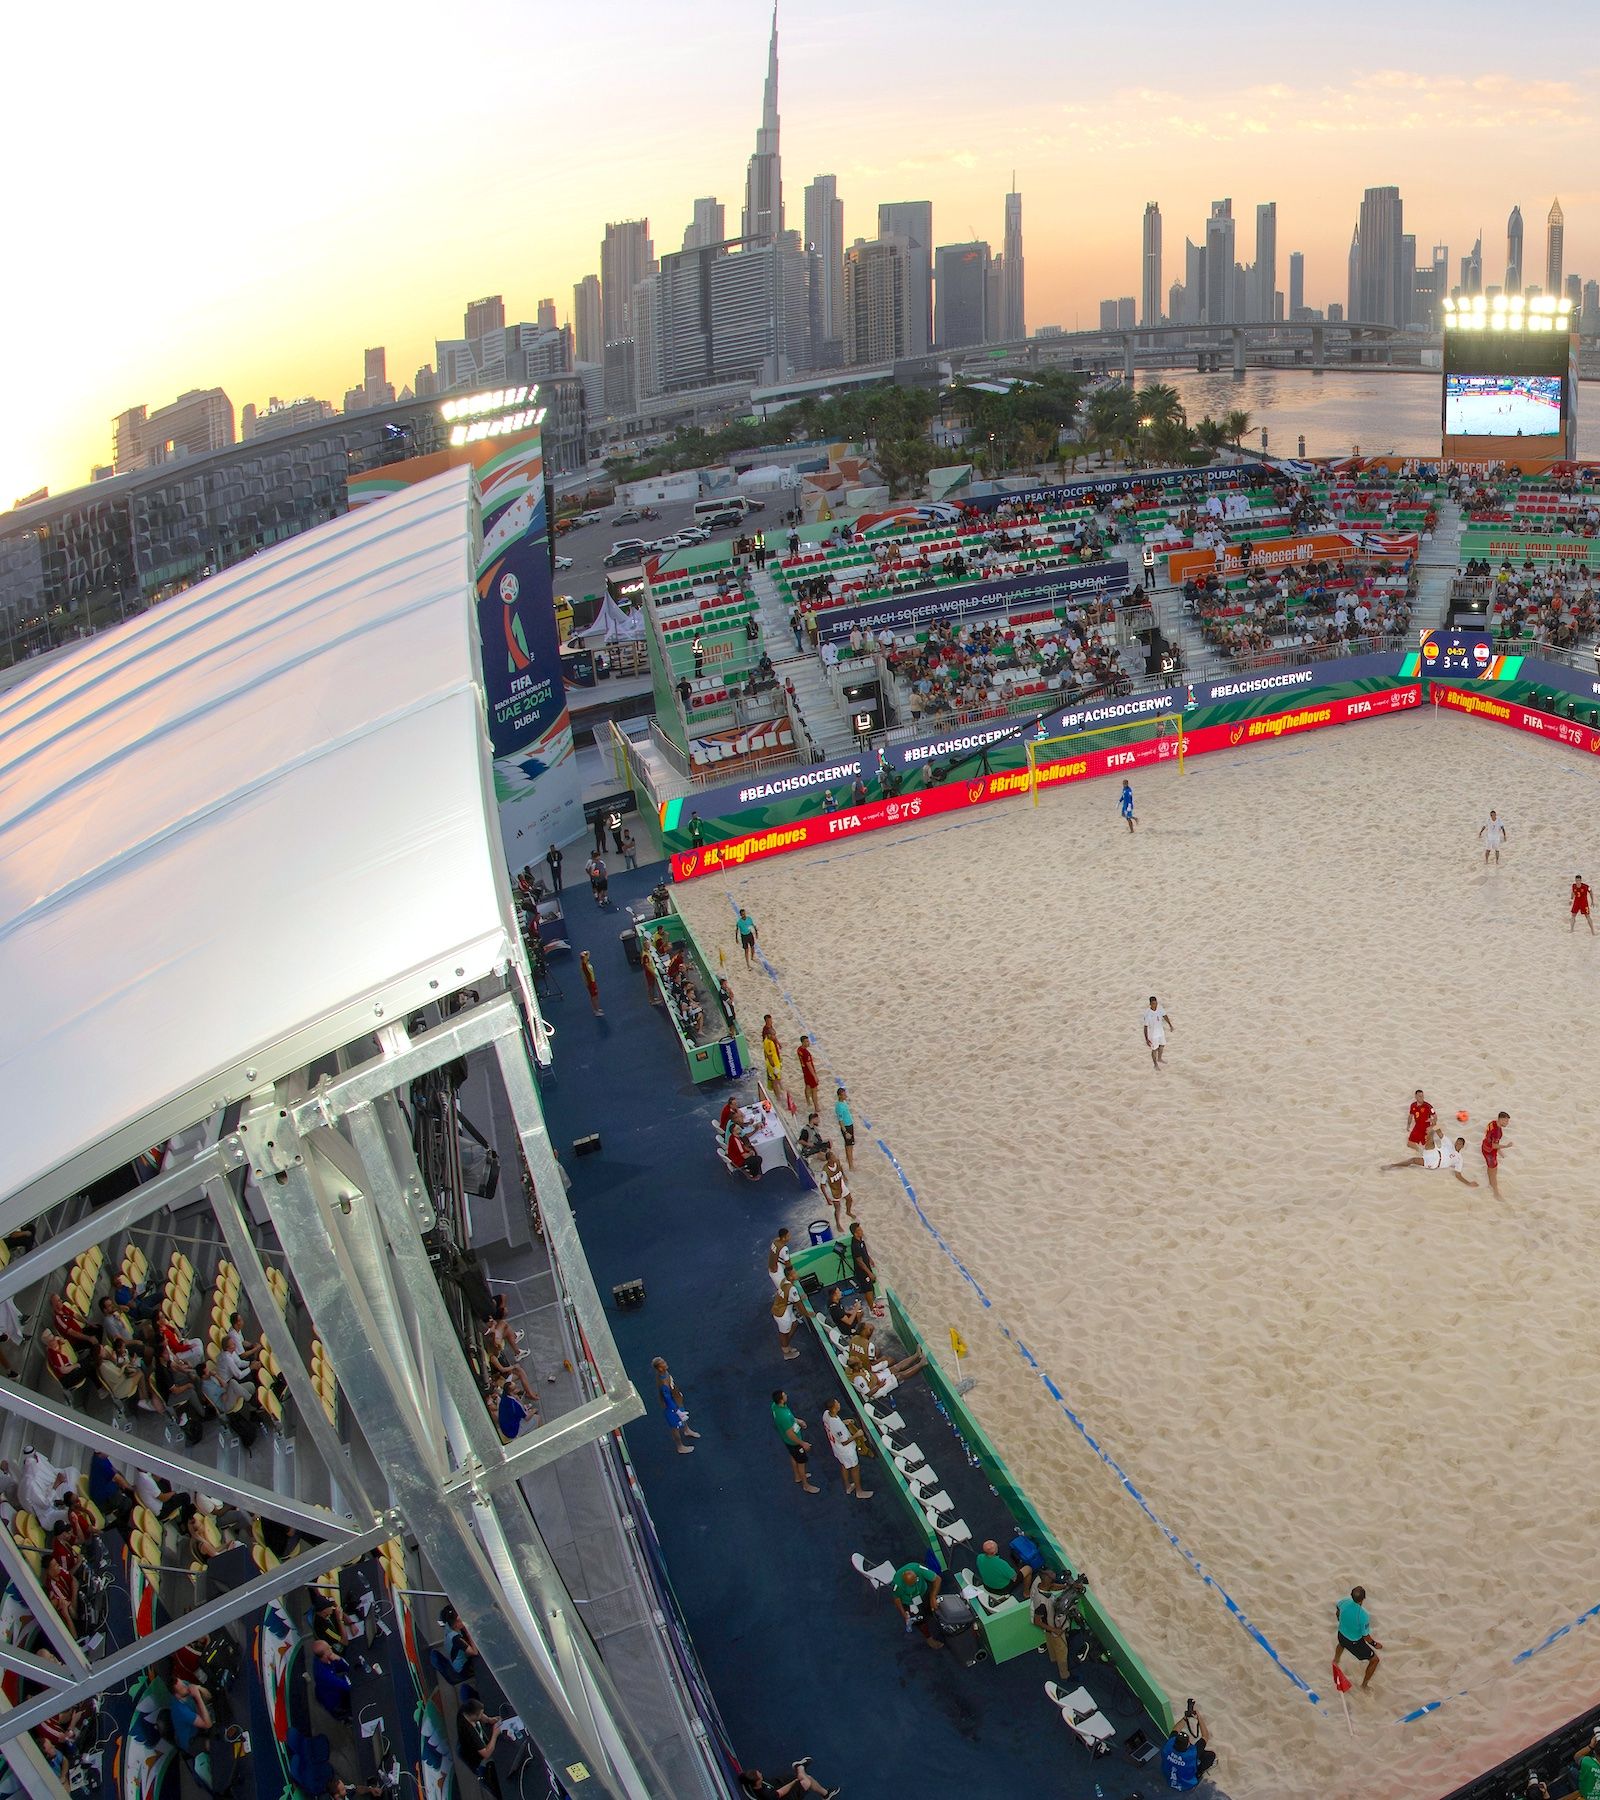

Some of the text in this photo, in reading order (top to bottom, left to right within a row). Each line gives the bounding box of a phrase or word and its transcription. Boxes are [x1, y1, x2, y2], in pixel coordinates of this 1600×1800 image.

[1095, 481, 1129, 494] WORD
[1489, 542, 1589, 560] MAKE YOUR MARK
[897, 604, 939, 621] SOCCER
[981, 592, 1002, 604] CUP
[1443, 656, 1451, 668] 3
[1460, 656, 1469, 669] 4
[510, 674, 532, 694] FIFA
[1211, 670, 1313, 699] #BEACHSOCCERWC
[497, 687, 552, 723] UAE 2024
[1061, 696, 1173, 728] #BEACHSOCCERWC
[1347, 701, 1371, 716] FIFA
[1447, 691, 1511, 720] #BringTheMoves
[514, 710, 541, 730] DUBAI
[1249, 708, 1331, 736] #BringTheMoves
[1523, 713, 1543, 730] FIFA
[1107, 751, 1136, 768] FIFA
[739, 762, 862, 803] #BEACHSOCCERWC
[829, 815, 862, 833] FIFA
[900, 800, 921, 818] 75
[851, 1343, 865, 1355] FIFA
